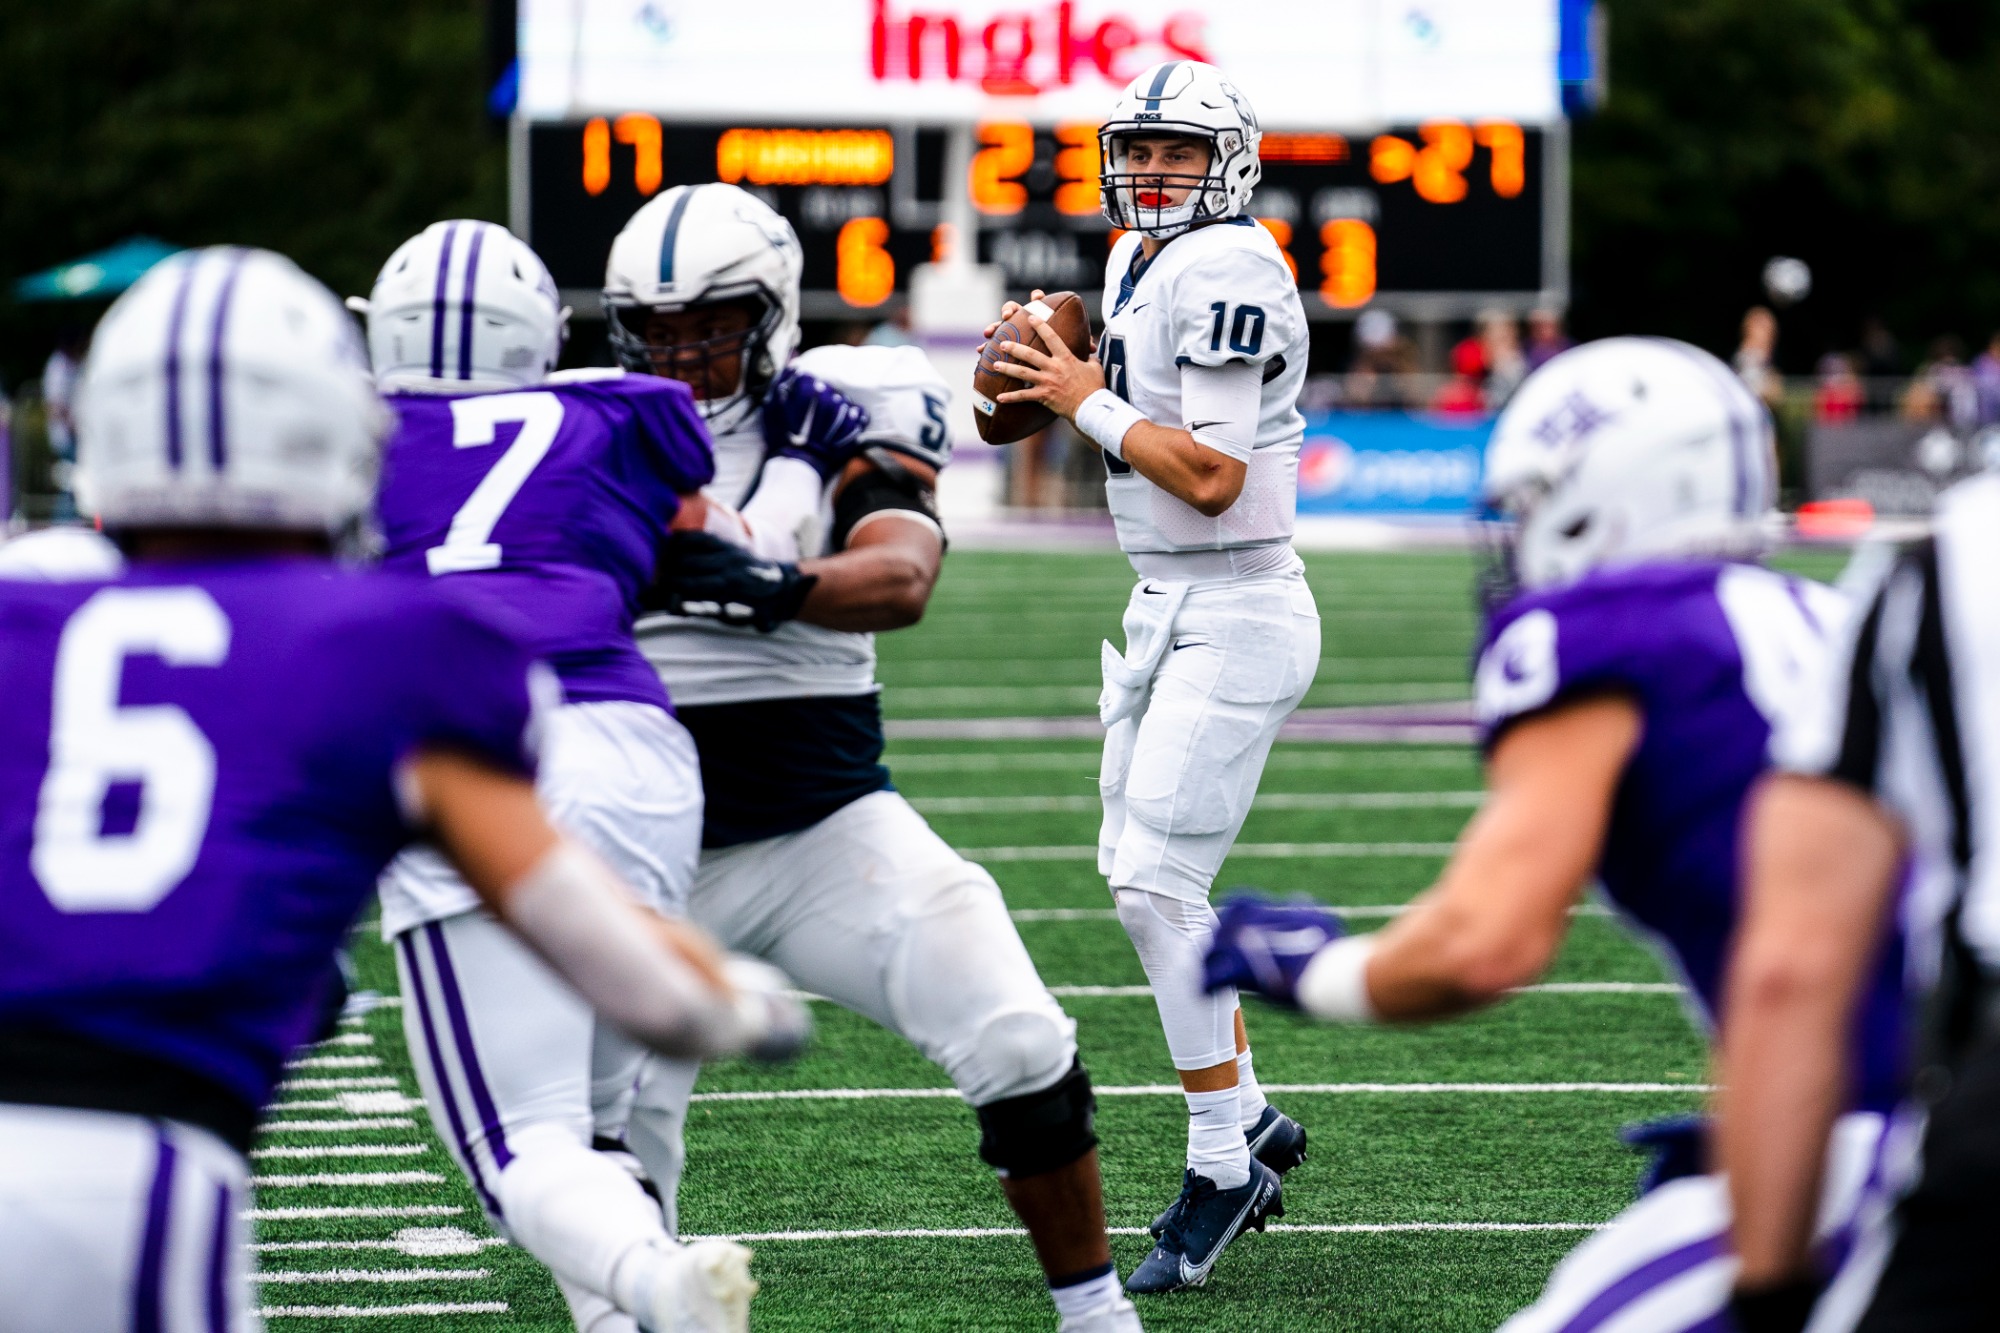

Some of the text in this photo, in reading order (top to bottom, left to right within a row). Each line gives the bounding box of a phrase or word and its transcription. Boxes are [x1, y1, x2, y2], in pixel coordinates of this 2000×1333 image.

[1134, 112, 1162, 121] DOGS
[837, 217, 895, 308] 6
[1208, 300, 1267, 356] 10
[427, 391, 564, 576] 7
[28, 585, 233, 915] 6
